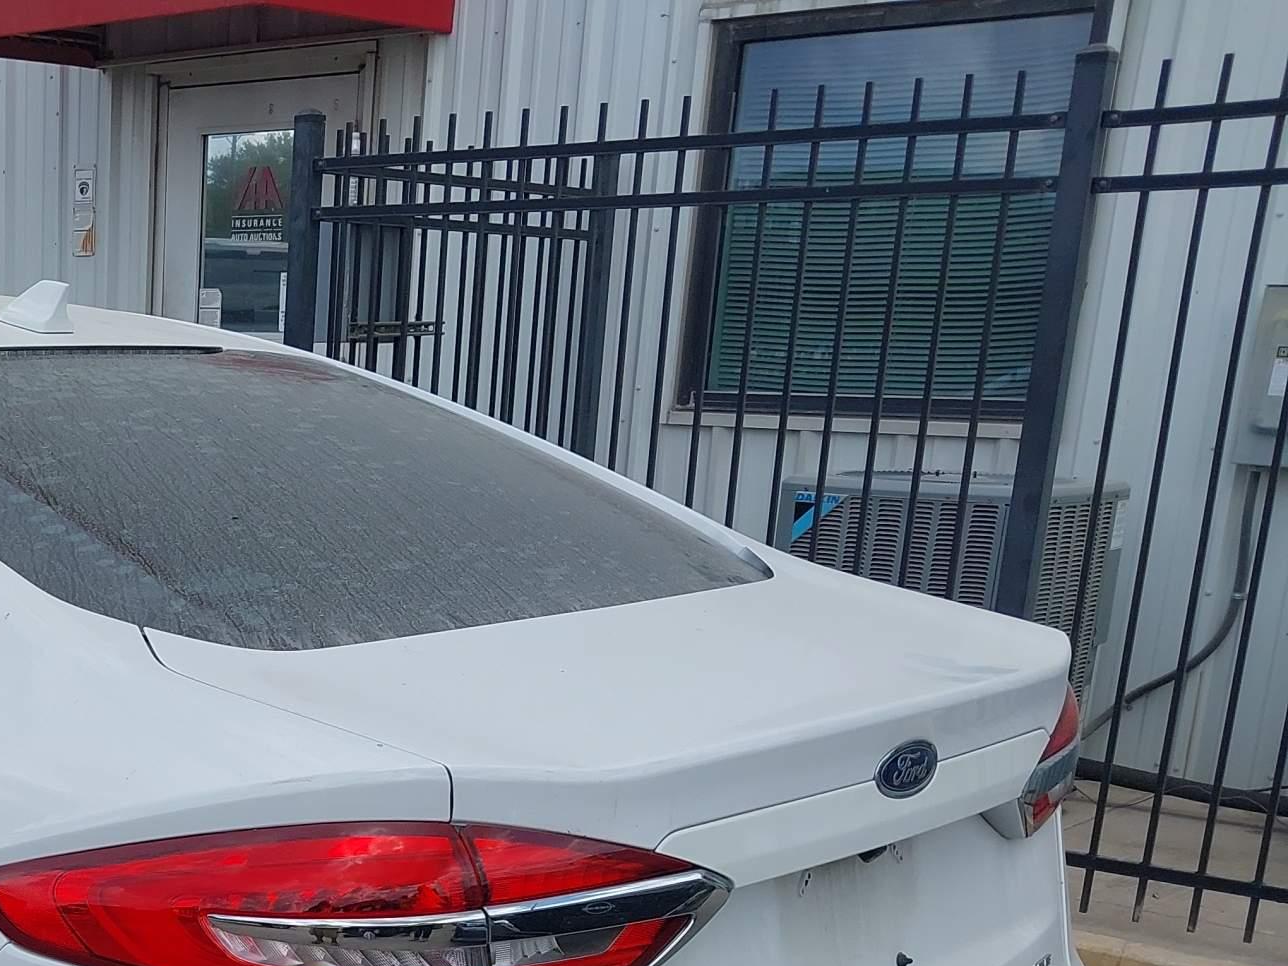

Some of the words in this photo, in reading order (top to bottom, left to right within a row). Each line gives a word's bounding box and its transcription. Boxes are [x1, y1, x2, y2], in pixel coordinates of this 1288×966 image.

[231, 217, 283, 228] INSURANCE
[231, 232, 249, 241] AUTO
[796, 492, 844, 505] DAIN
[892, 751, 929, 786] Ford
